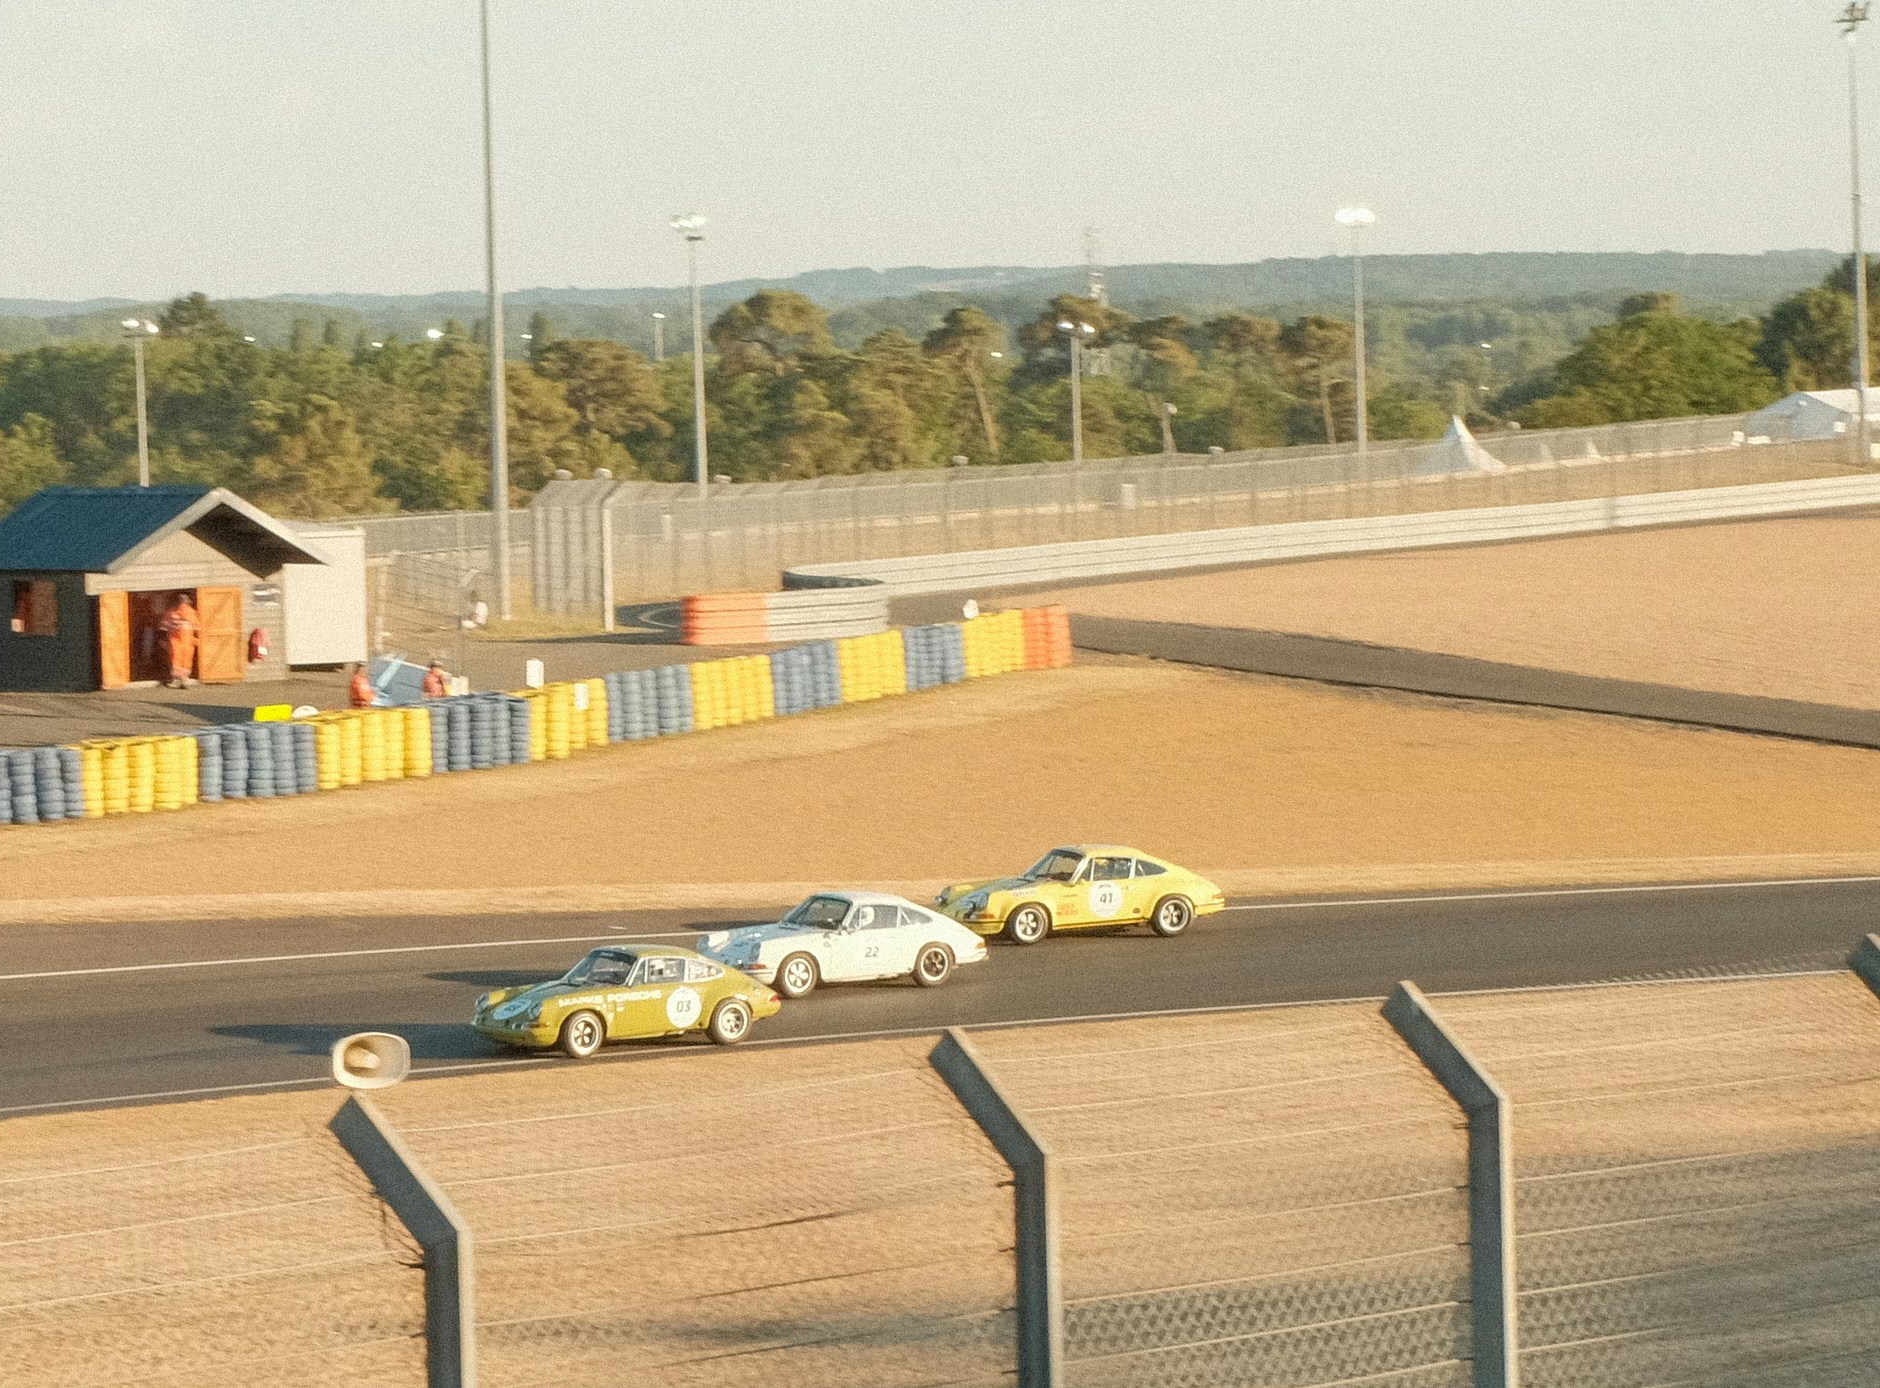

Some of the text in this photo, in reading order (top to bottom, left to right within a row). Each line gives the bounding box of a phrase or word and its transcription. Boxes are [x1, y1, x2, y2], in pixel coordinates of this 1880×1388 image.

[1099, 892, 1113, 904] 41
[864, 945, 880, 959] 22
[676, 999, 691, 1013] 03
